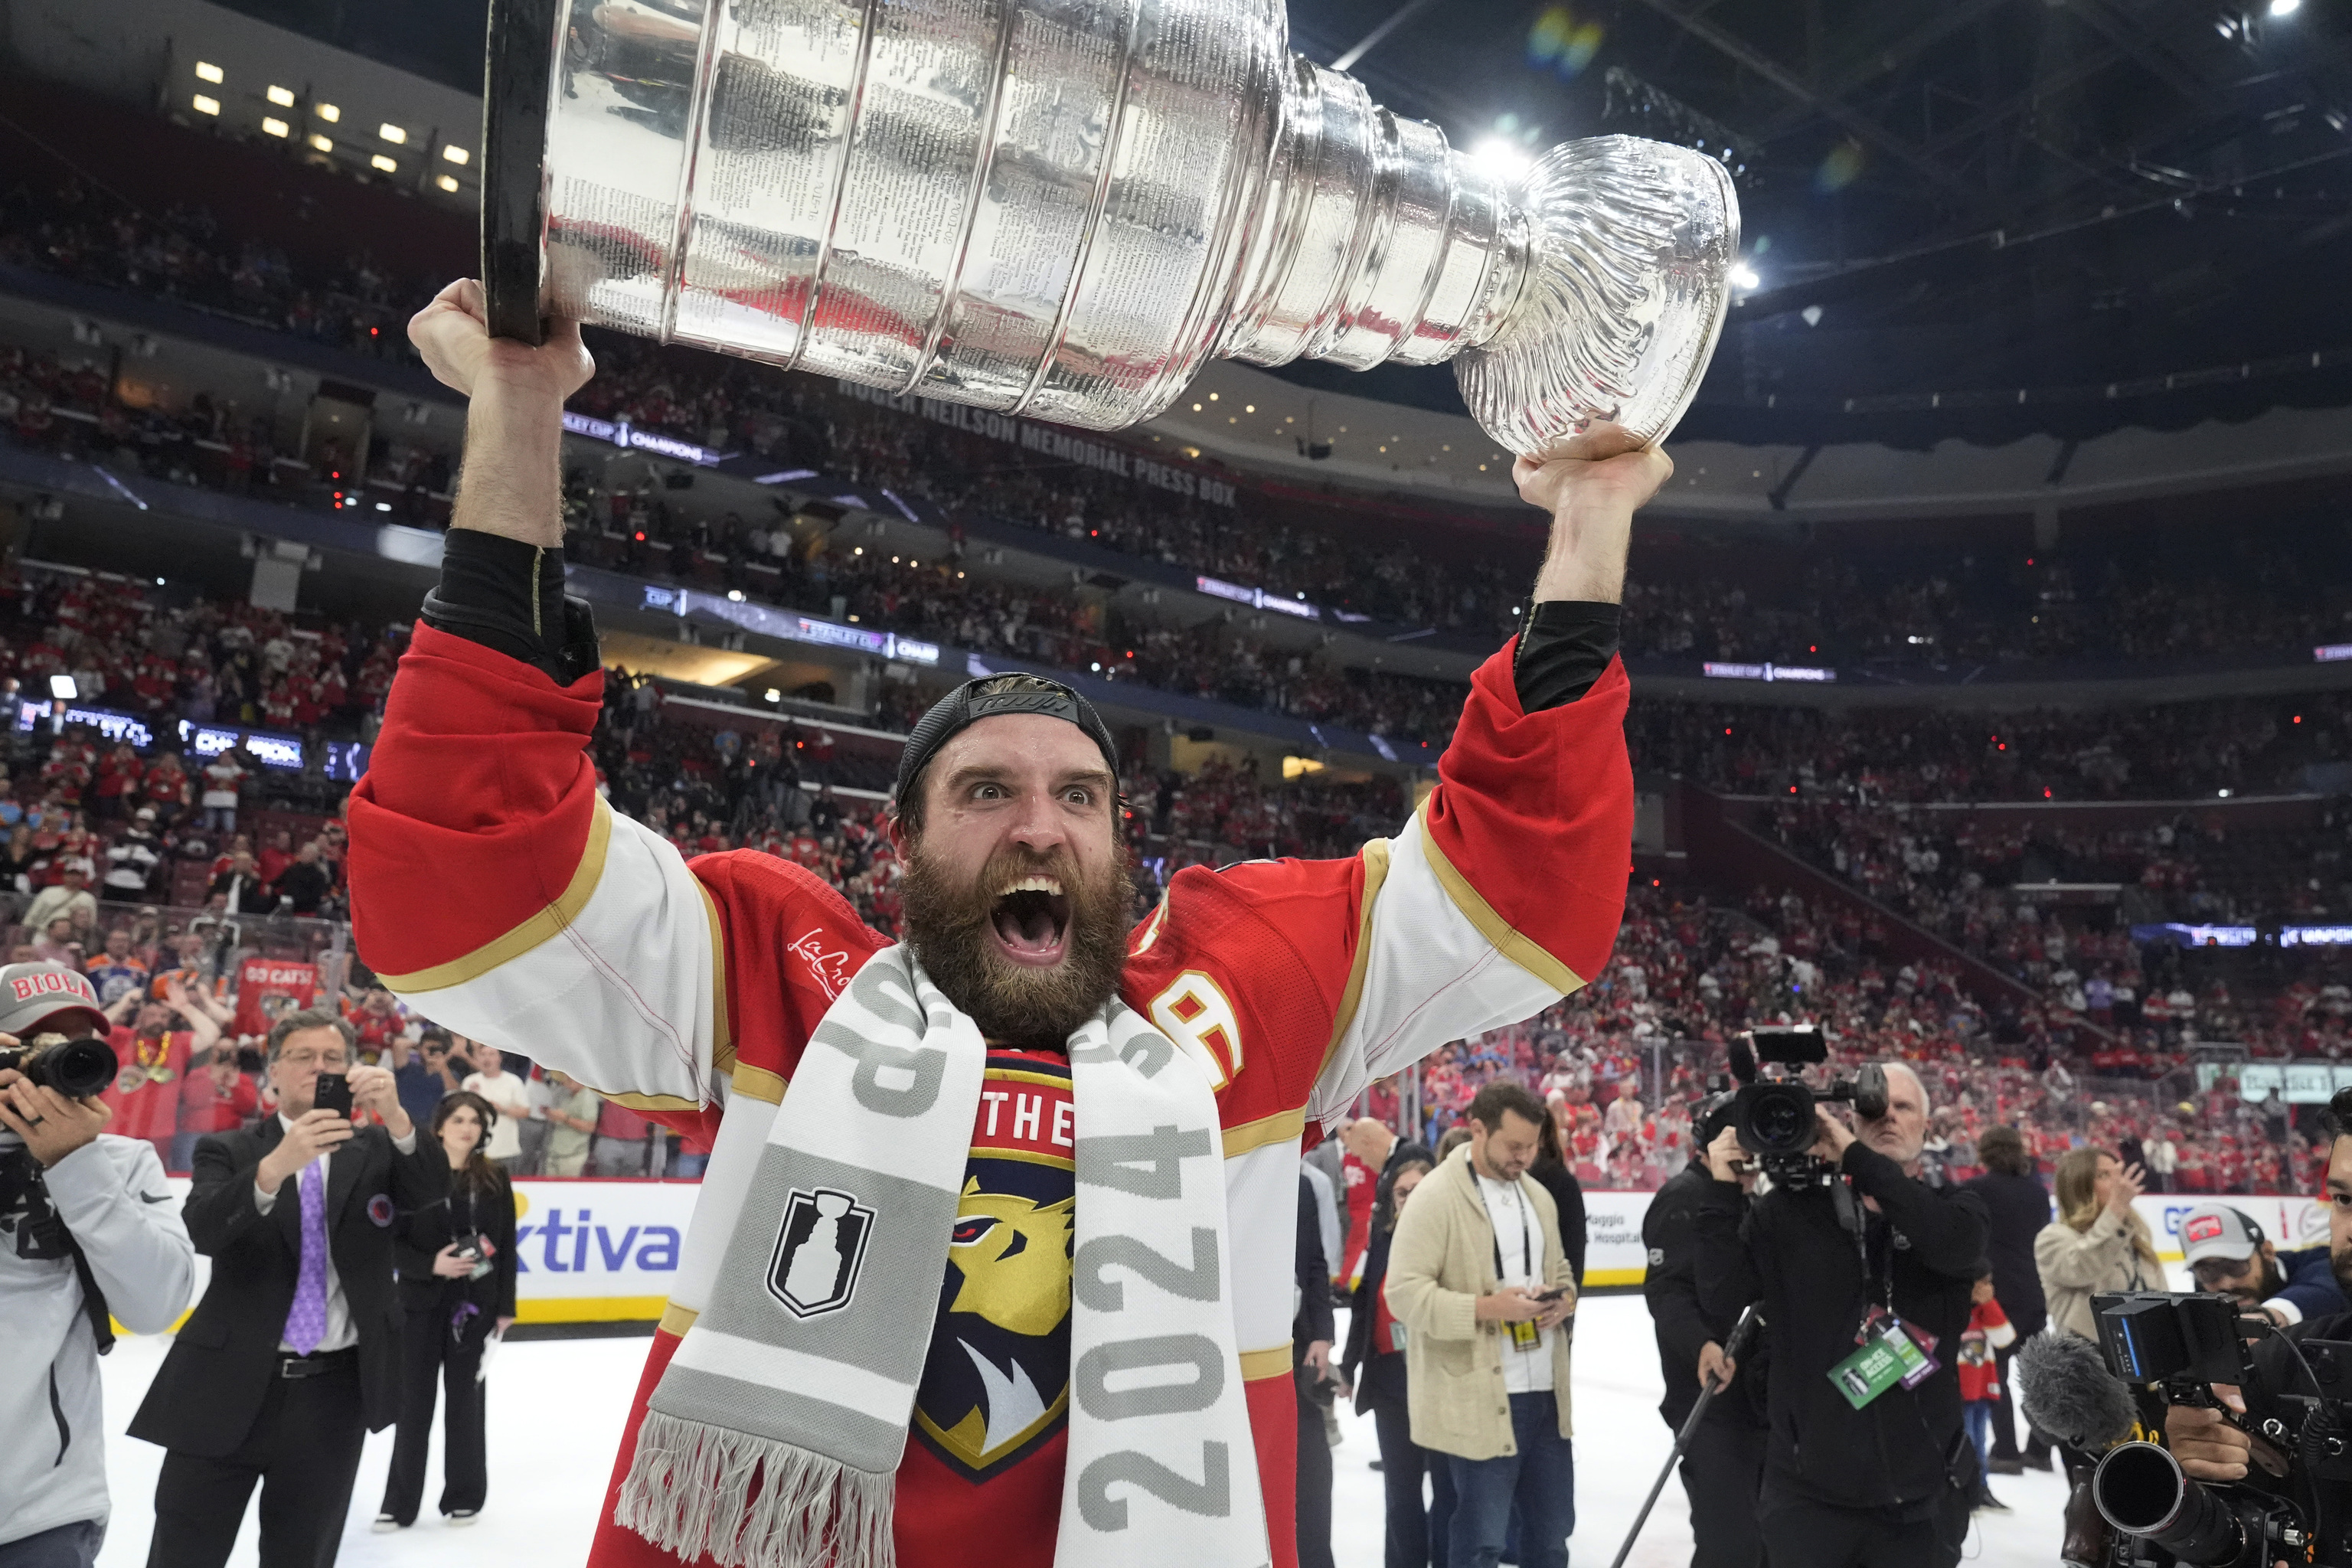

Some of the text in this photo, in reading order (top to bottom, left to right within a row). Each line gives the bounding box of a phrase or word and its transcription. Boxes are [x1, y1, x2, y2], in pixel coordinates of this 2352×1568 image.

[922, 395, 1018, 444] NEILSON
[1021, 420, 1131, 479] MEMORIAL
[1134, 455, 1195, 496] PRESS
[1199, 475, 1236, 508] BOX
[10, 972, 93, 1002] BIOLA
[1074, 1123, 1230, 1533] 2024
